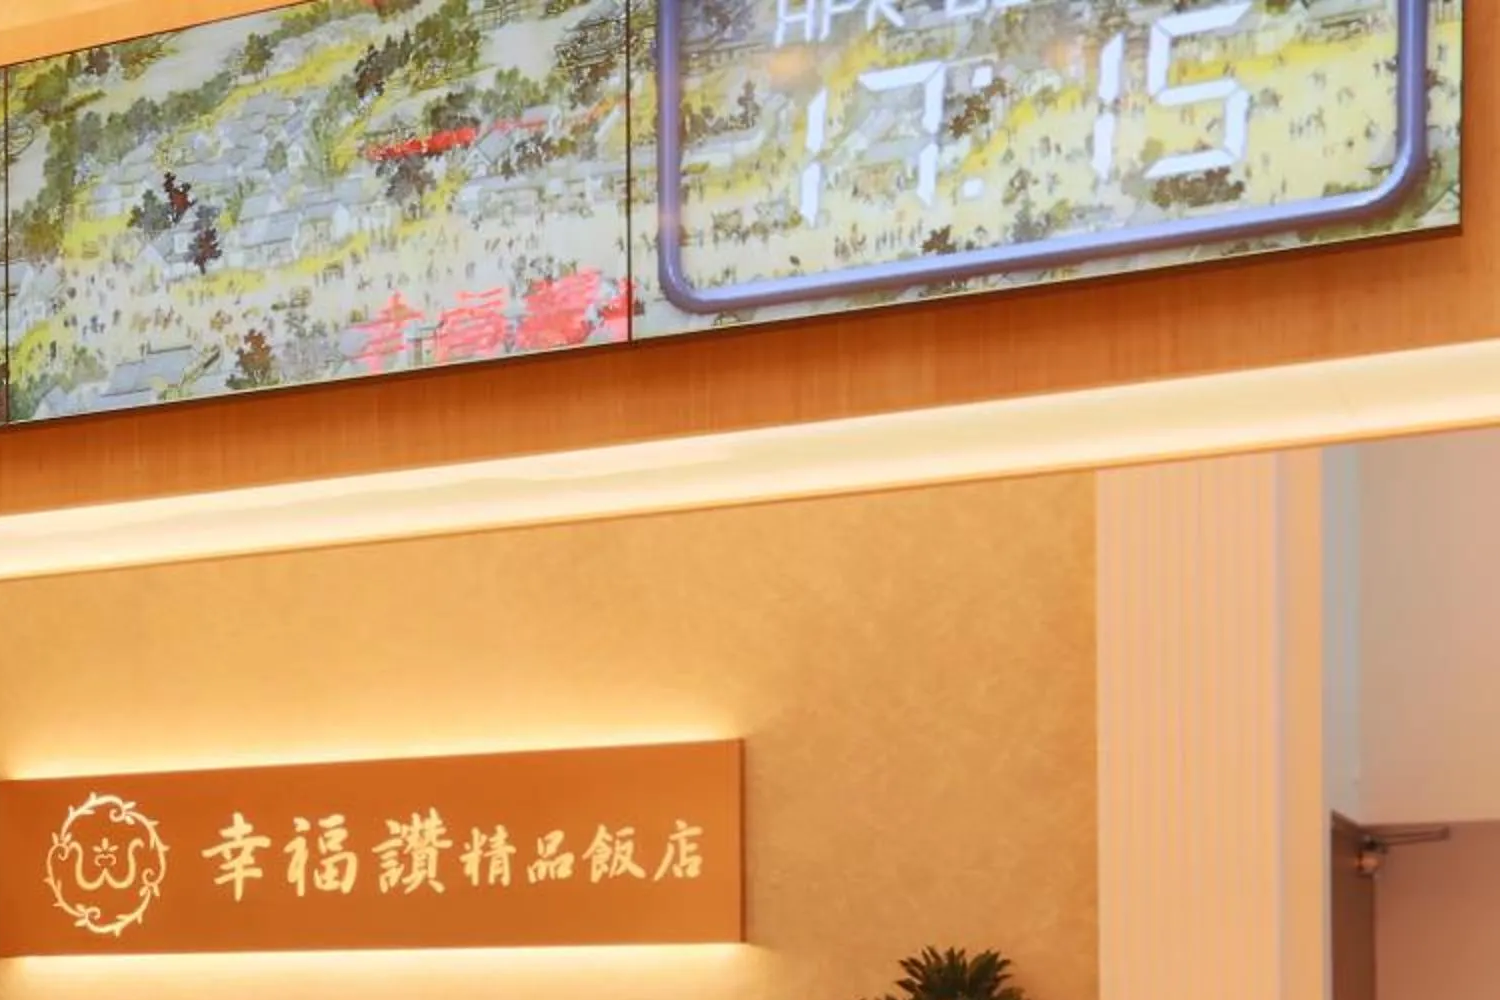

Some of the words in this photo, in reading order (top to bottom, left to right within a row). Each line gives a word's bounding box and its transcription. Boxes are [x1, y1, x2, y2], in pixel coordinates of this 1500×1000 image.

[800, 2, 1250, 226] 17:15
[201, 806, 705, 902] 幸福讚精品飯店
